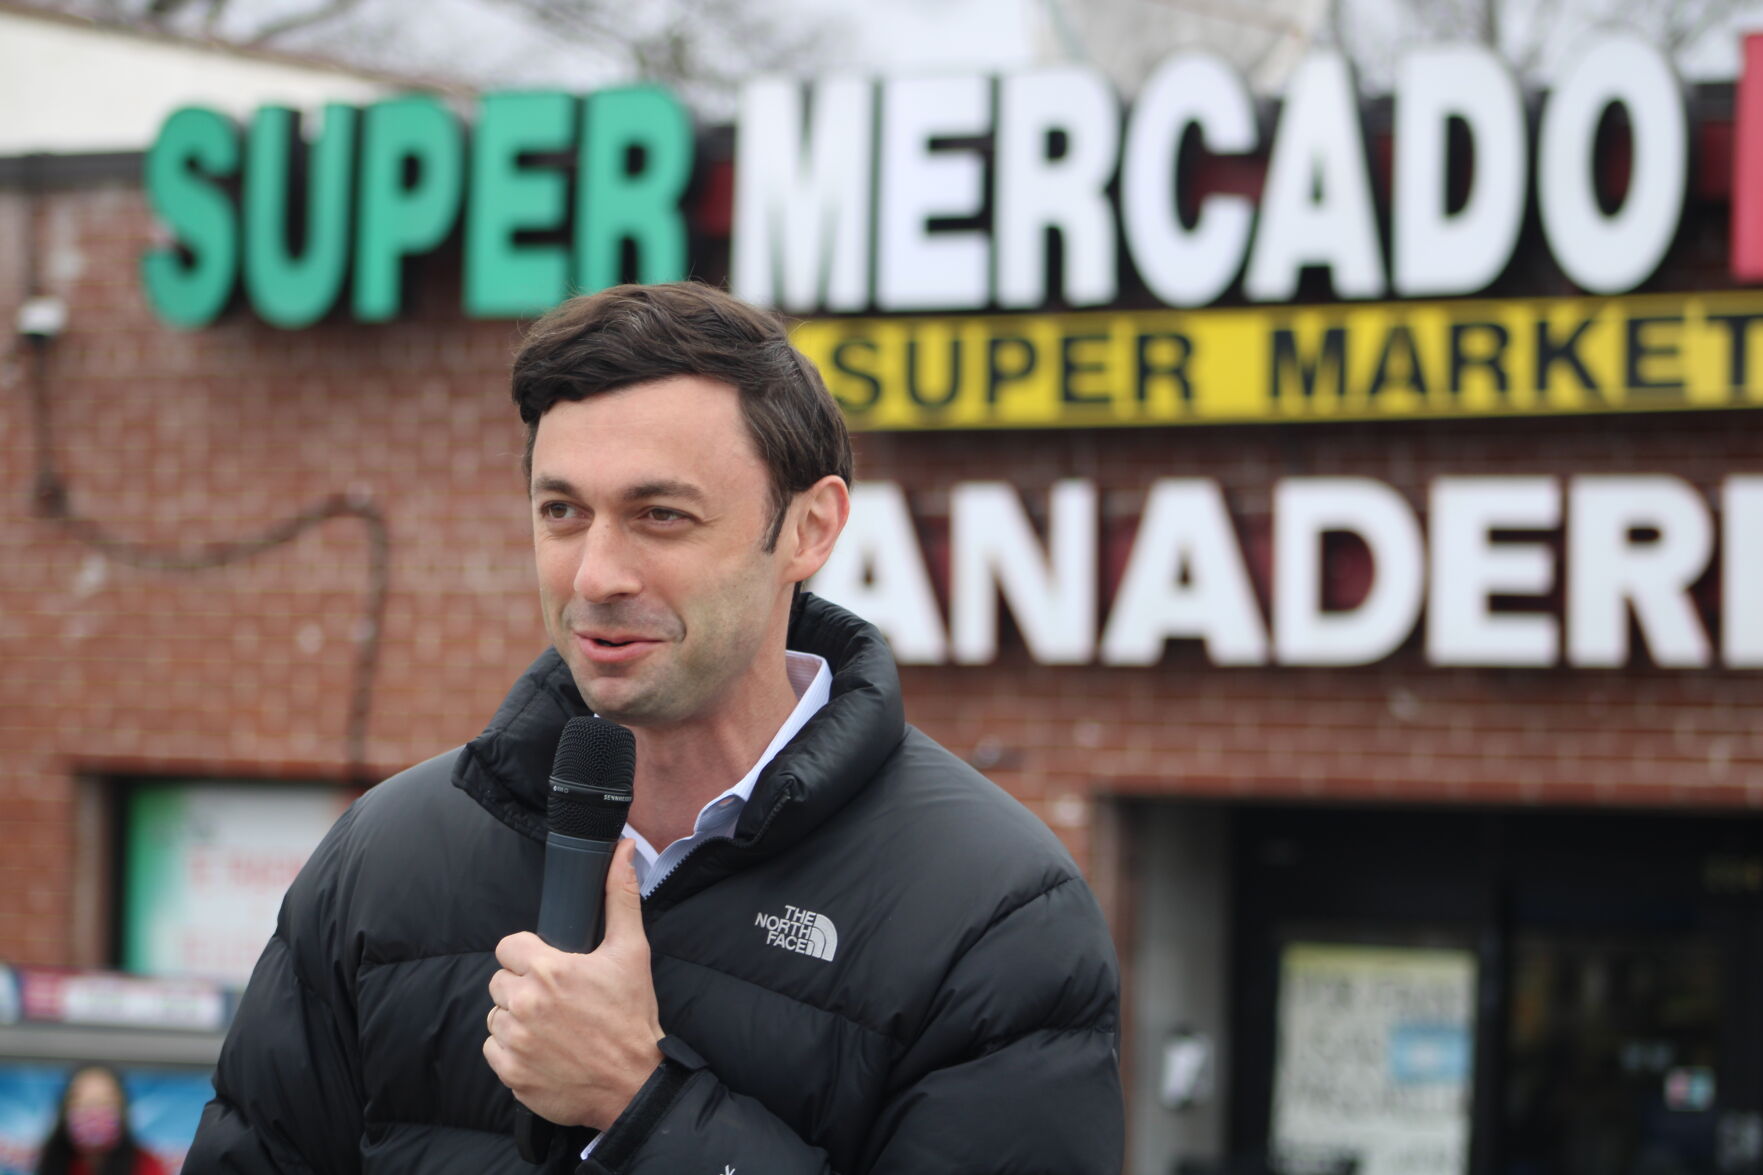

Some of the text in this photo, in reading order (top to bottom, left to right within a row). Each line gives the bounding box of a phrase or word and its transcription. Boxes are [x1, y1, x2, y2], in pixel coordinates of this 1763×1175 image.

[142, 82, 694, 328] SUPER
[732, 36, 1688, 312] MERCADO
[829, 315, 1763, 412] SUPER MARKET
[754, 912, 812, 940] NORTH
[785, 904, 817, 926] THE
[766, 930, 808, 954] FACE
